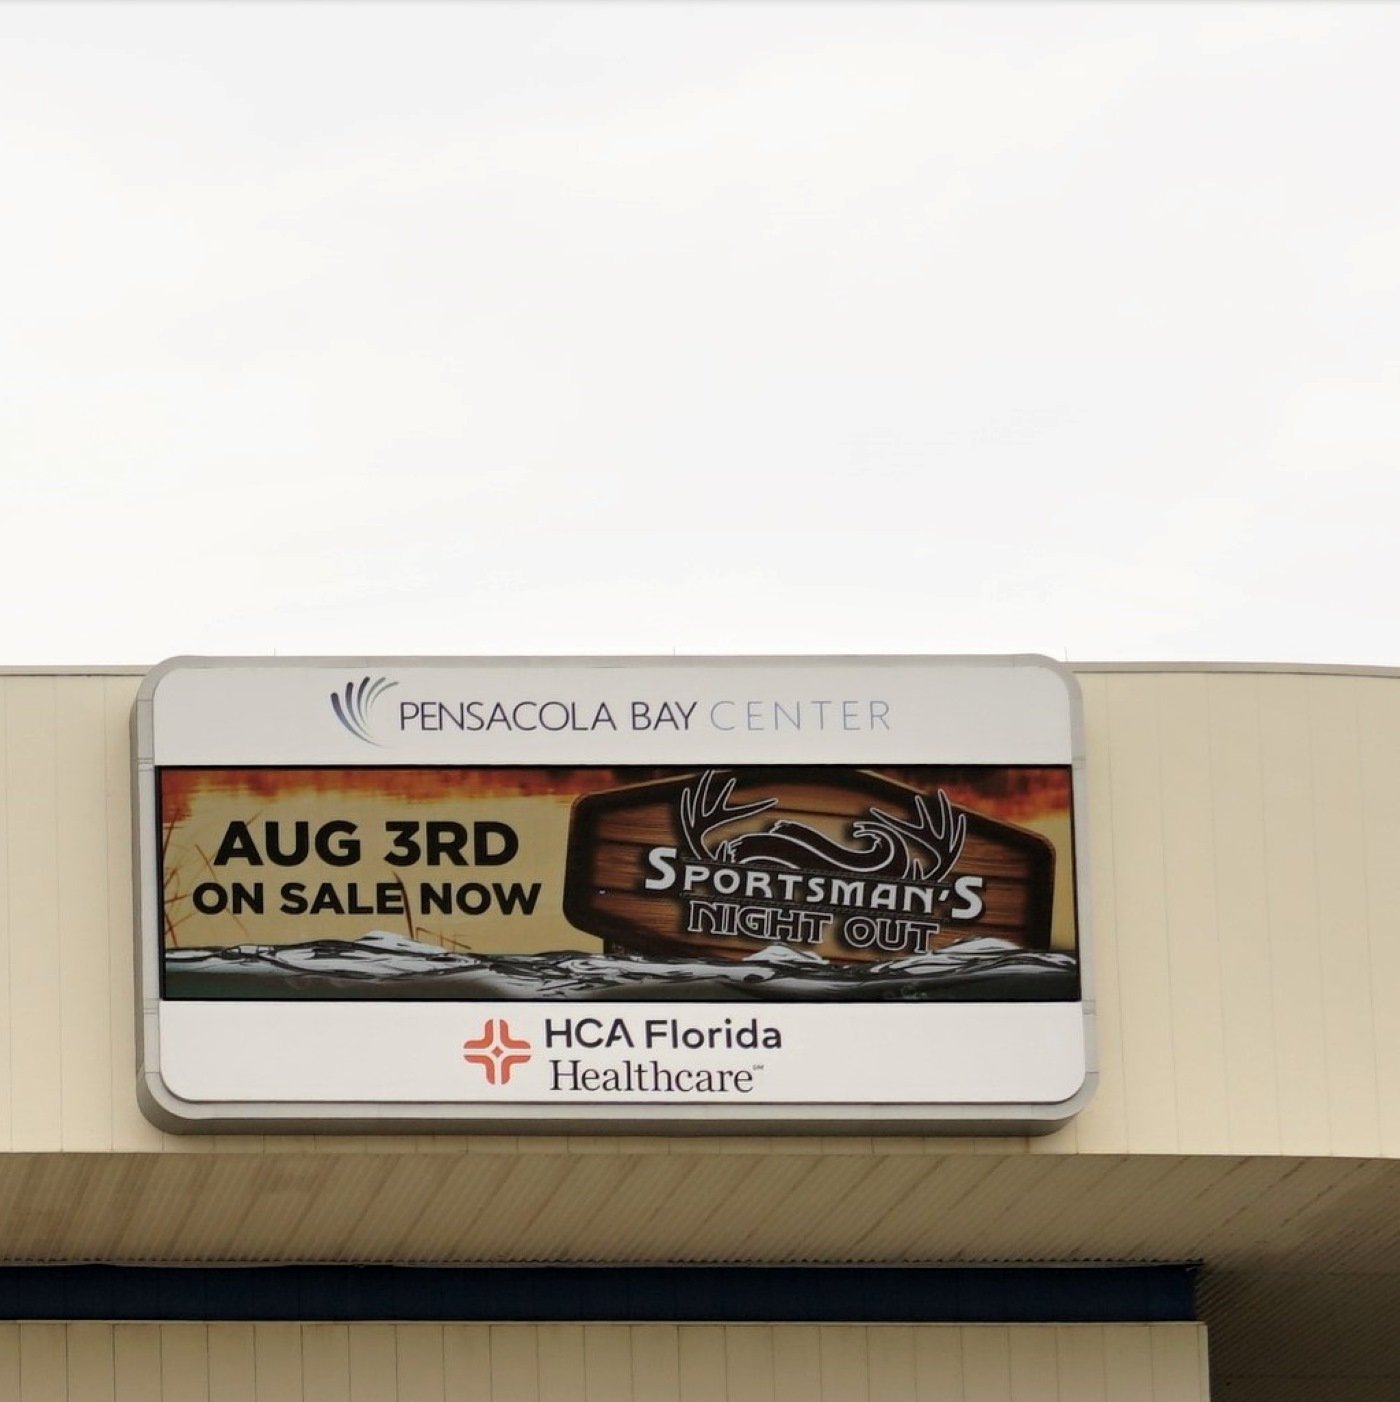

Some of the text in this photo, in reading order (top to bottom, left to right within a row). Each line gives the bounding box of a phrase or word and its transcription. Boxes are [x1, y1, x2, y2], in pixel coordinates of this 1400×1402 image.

[400, 700, 890, 731] PENSACOLA BAY CENTER
[213, 820, 519, 867] AUG 3RD
[192, 882, 542, 915] ON SALE NOW
[645, 847, 983, 920] SPORTSMAN'S
[688, 901, 940, 953] NIGHT OUT
[545, 1018, 782, 1049] HCA Florida
[549, 1060, 753, 1093] Healthcare
